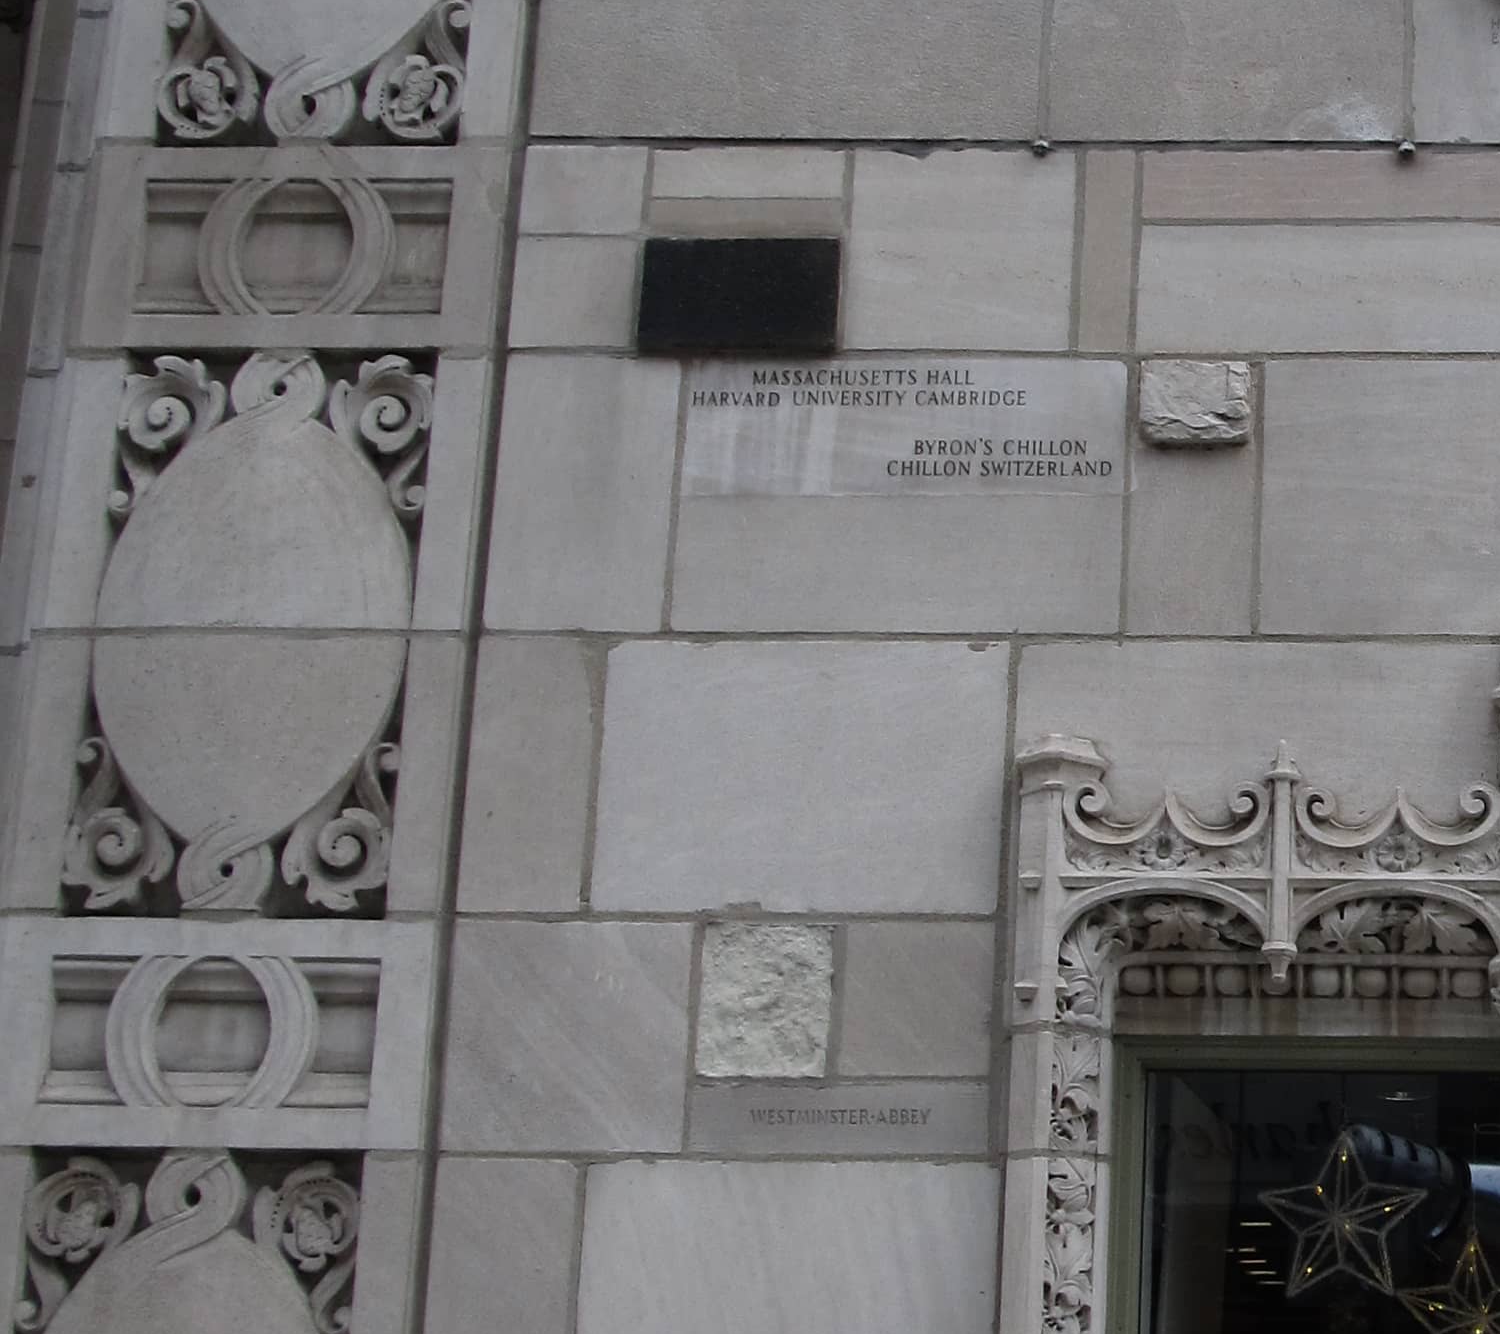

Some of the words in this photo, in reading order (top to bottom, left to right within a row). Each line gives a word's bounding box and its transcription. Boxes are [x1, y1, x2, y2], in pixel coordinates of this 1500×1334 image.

[752, 369, 917, 386] MASSACHUSETTS
[926, 369, 975, 386] HALL
[692, 390, 781, 408] HARVARD
[793, 390, 906, 407] UNIVERSITY
[914, 390, 1027, 407] CAMBRIDGE
[914, 437, 993, 457] BYRON'S
[1003, 439, 1088, 457] CHILLON
[887, 460, 971, 478] CHILLON
[980, 460, 1113, 478] SWITZERLAND
